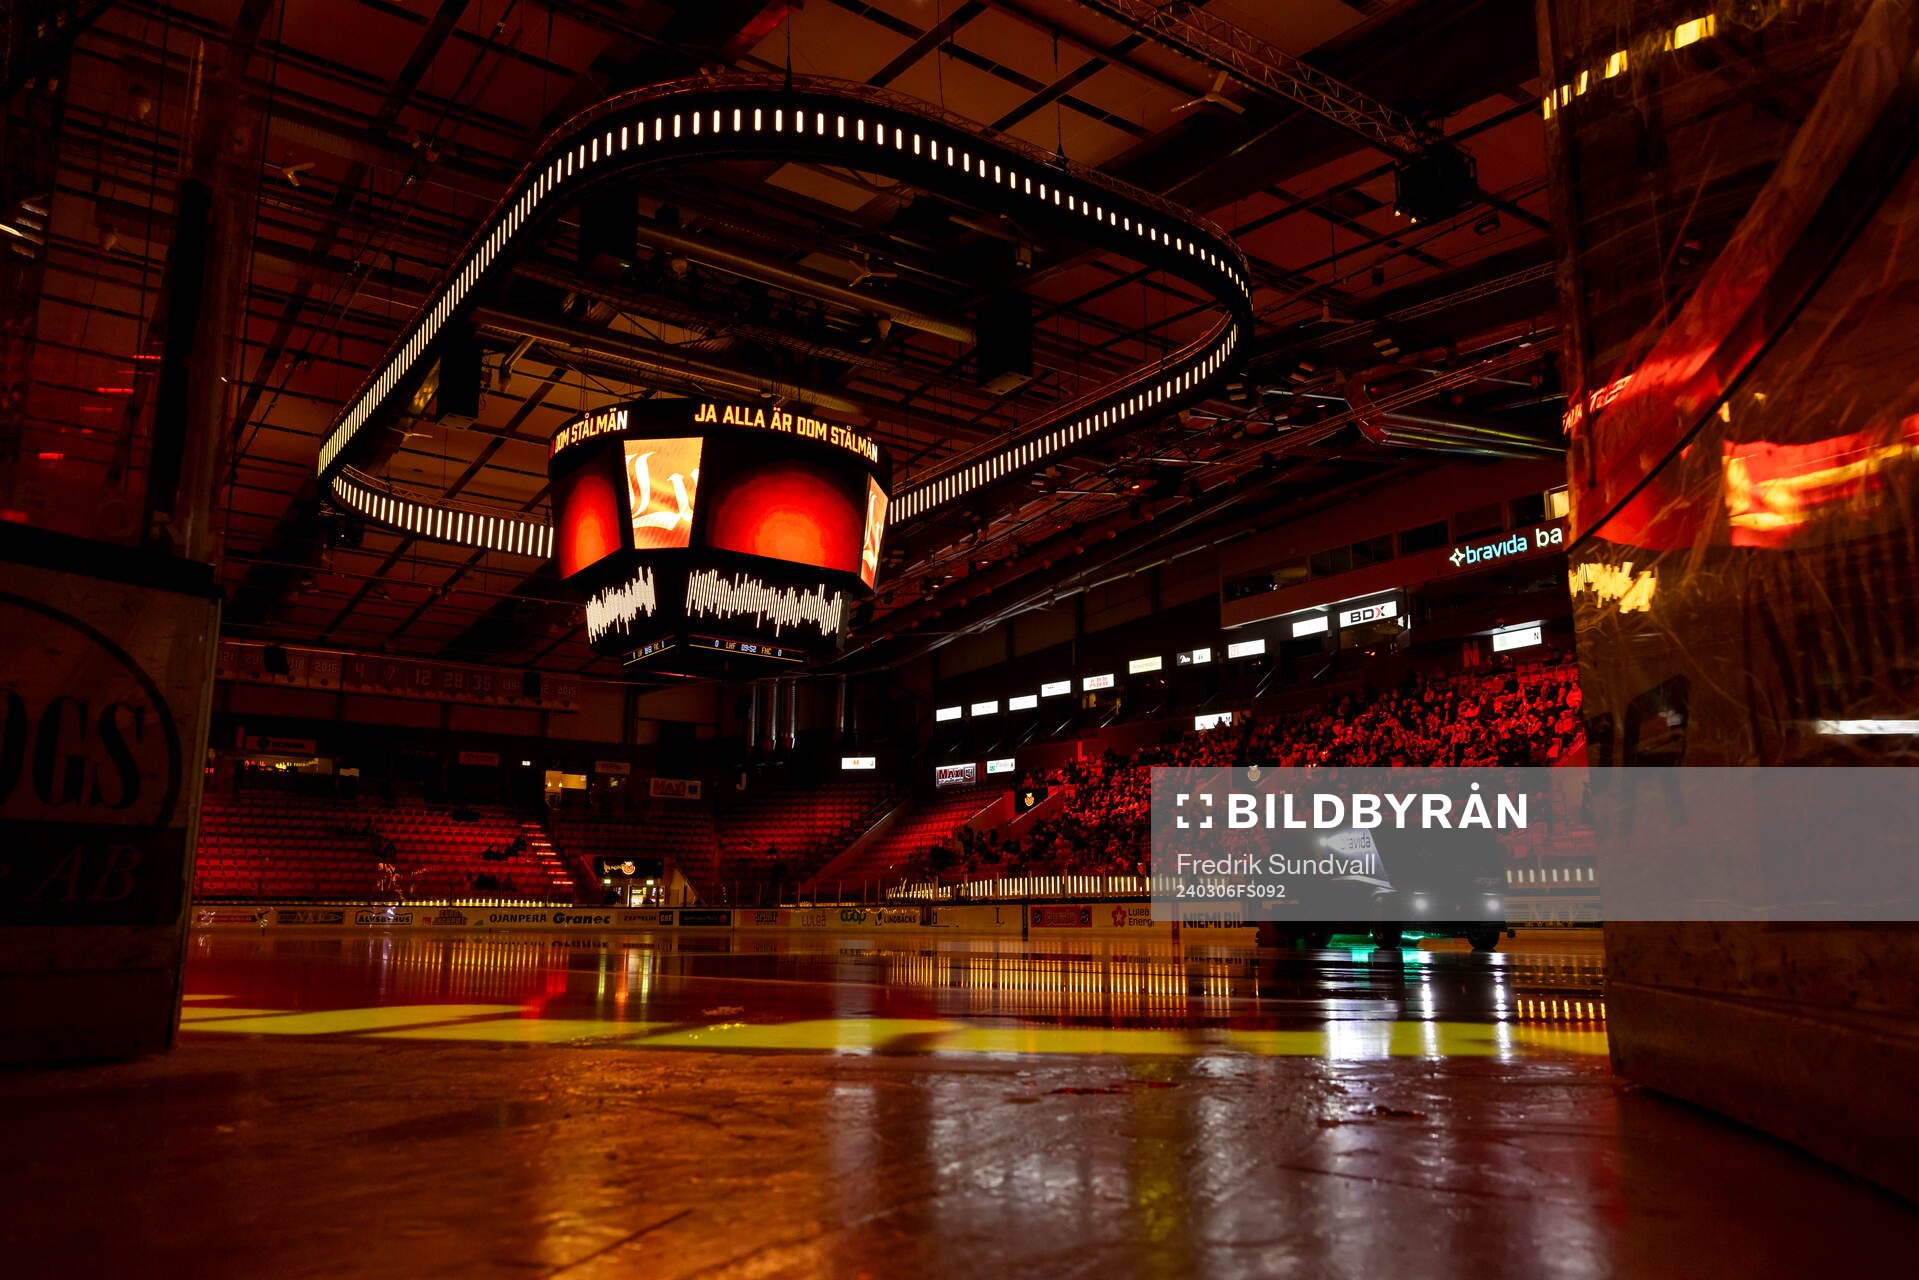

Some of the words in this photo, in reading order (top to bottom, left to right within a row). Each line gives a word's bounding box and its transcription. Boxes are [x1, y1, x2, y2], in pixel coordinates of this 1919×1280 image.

[554, 427, 570, 454] DOM
[571, 407, 628, 443] STÅLMÄN
[694, 403, 717, 423] JA
[722, 405, 766, 429] ALLA
[770, 406, 793, 433] ÄR
[797, 416, 828, 442] DOM
[830, 424, 878, 463] STÅLMÄN
[1466, 534, 1528, 564] bravida
[1349, 605, 1386, 624] BDX
[938, 768, 963, 780] MAXI
[22, 843, 141, 903] AB
[553, 912, 611, 924] Granec
[840, 909, 866, 925] coop
[1128, 917, 1155, 927] Energi
[1183, 912, 1221, 928] NIEMI
